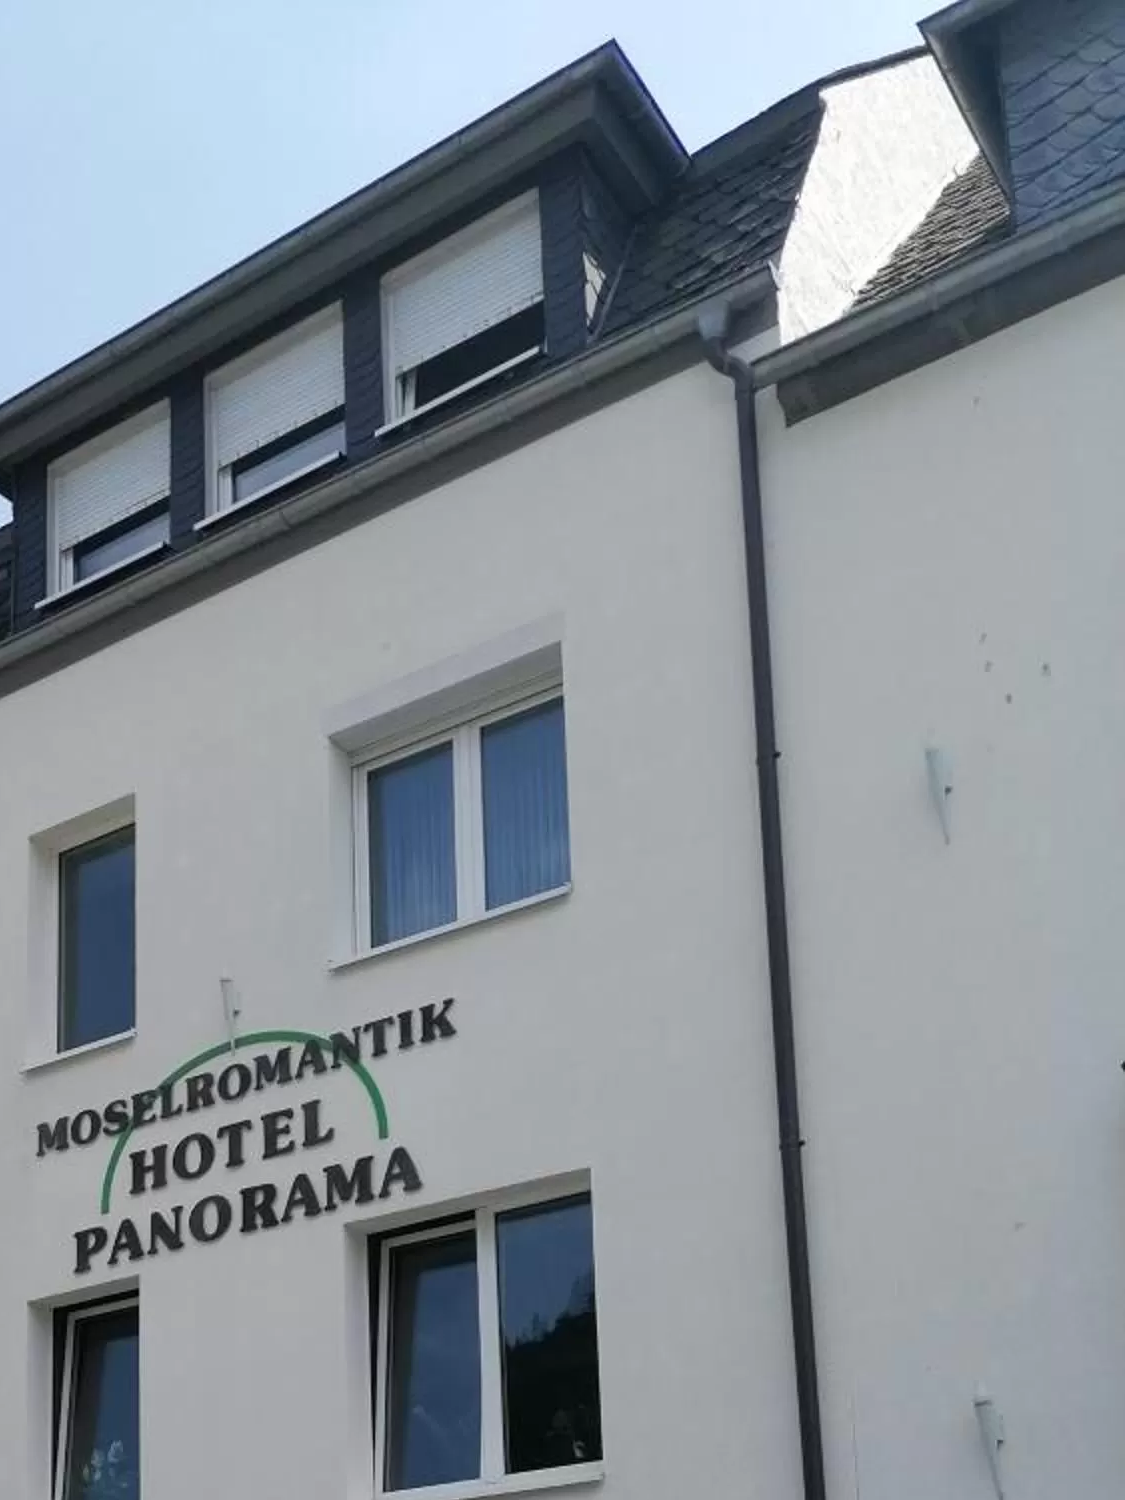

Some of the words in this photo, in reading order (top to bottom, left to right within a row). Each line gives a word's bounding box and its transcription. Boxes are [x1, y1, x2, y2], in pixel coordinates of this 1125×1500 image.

[36, 998, 457, 1157] MOSELROMANTIK
[74, 1146, 423, 1273] PANORAMA
[129, 1100, 335, 1195] HOTEL
